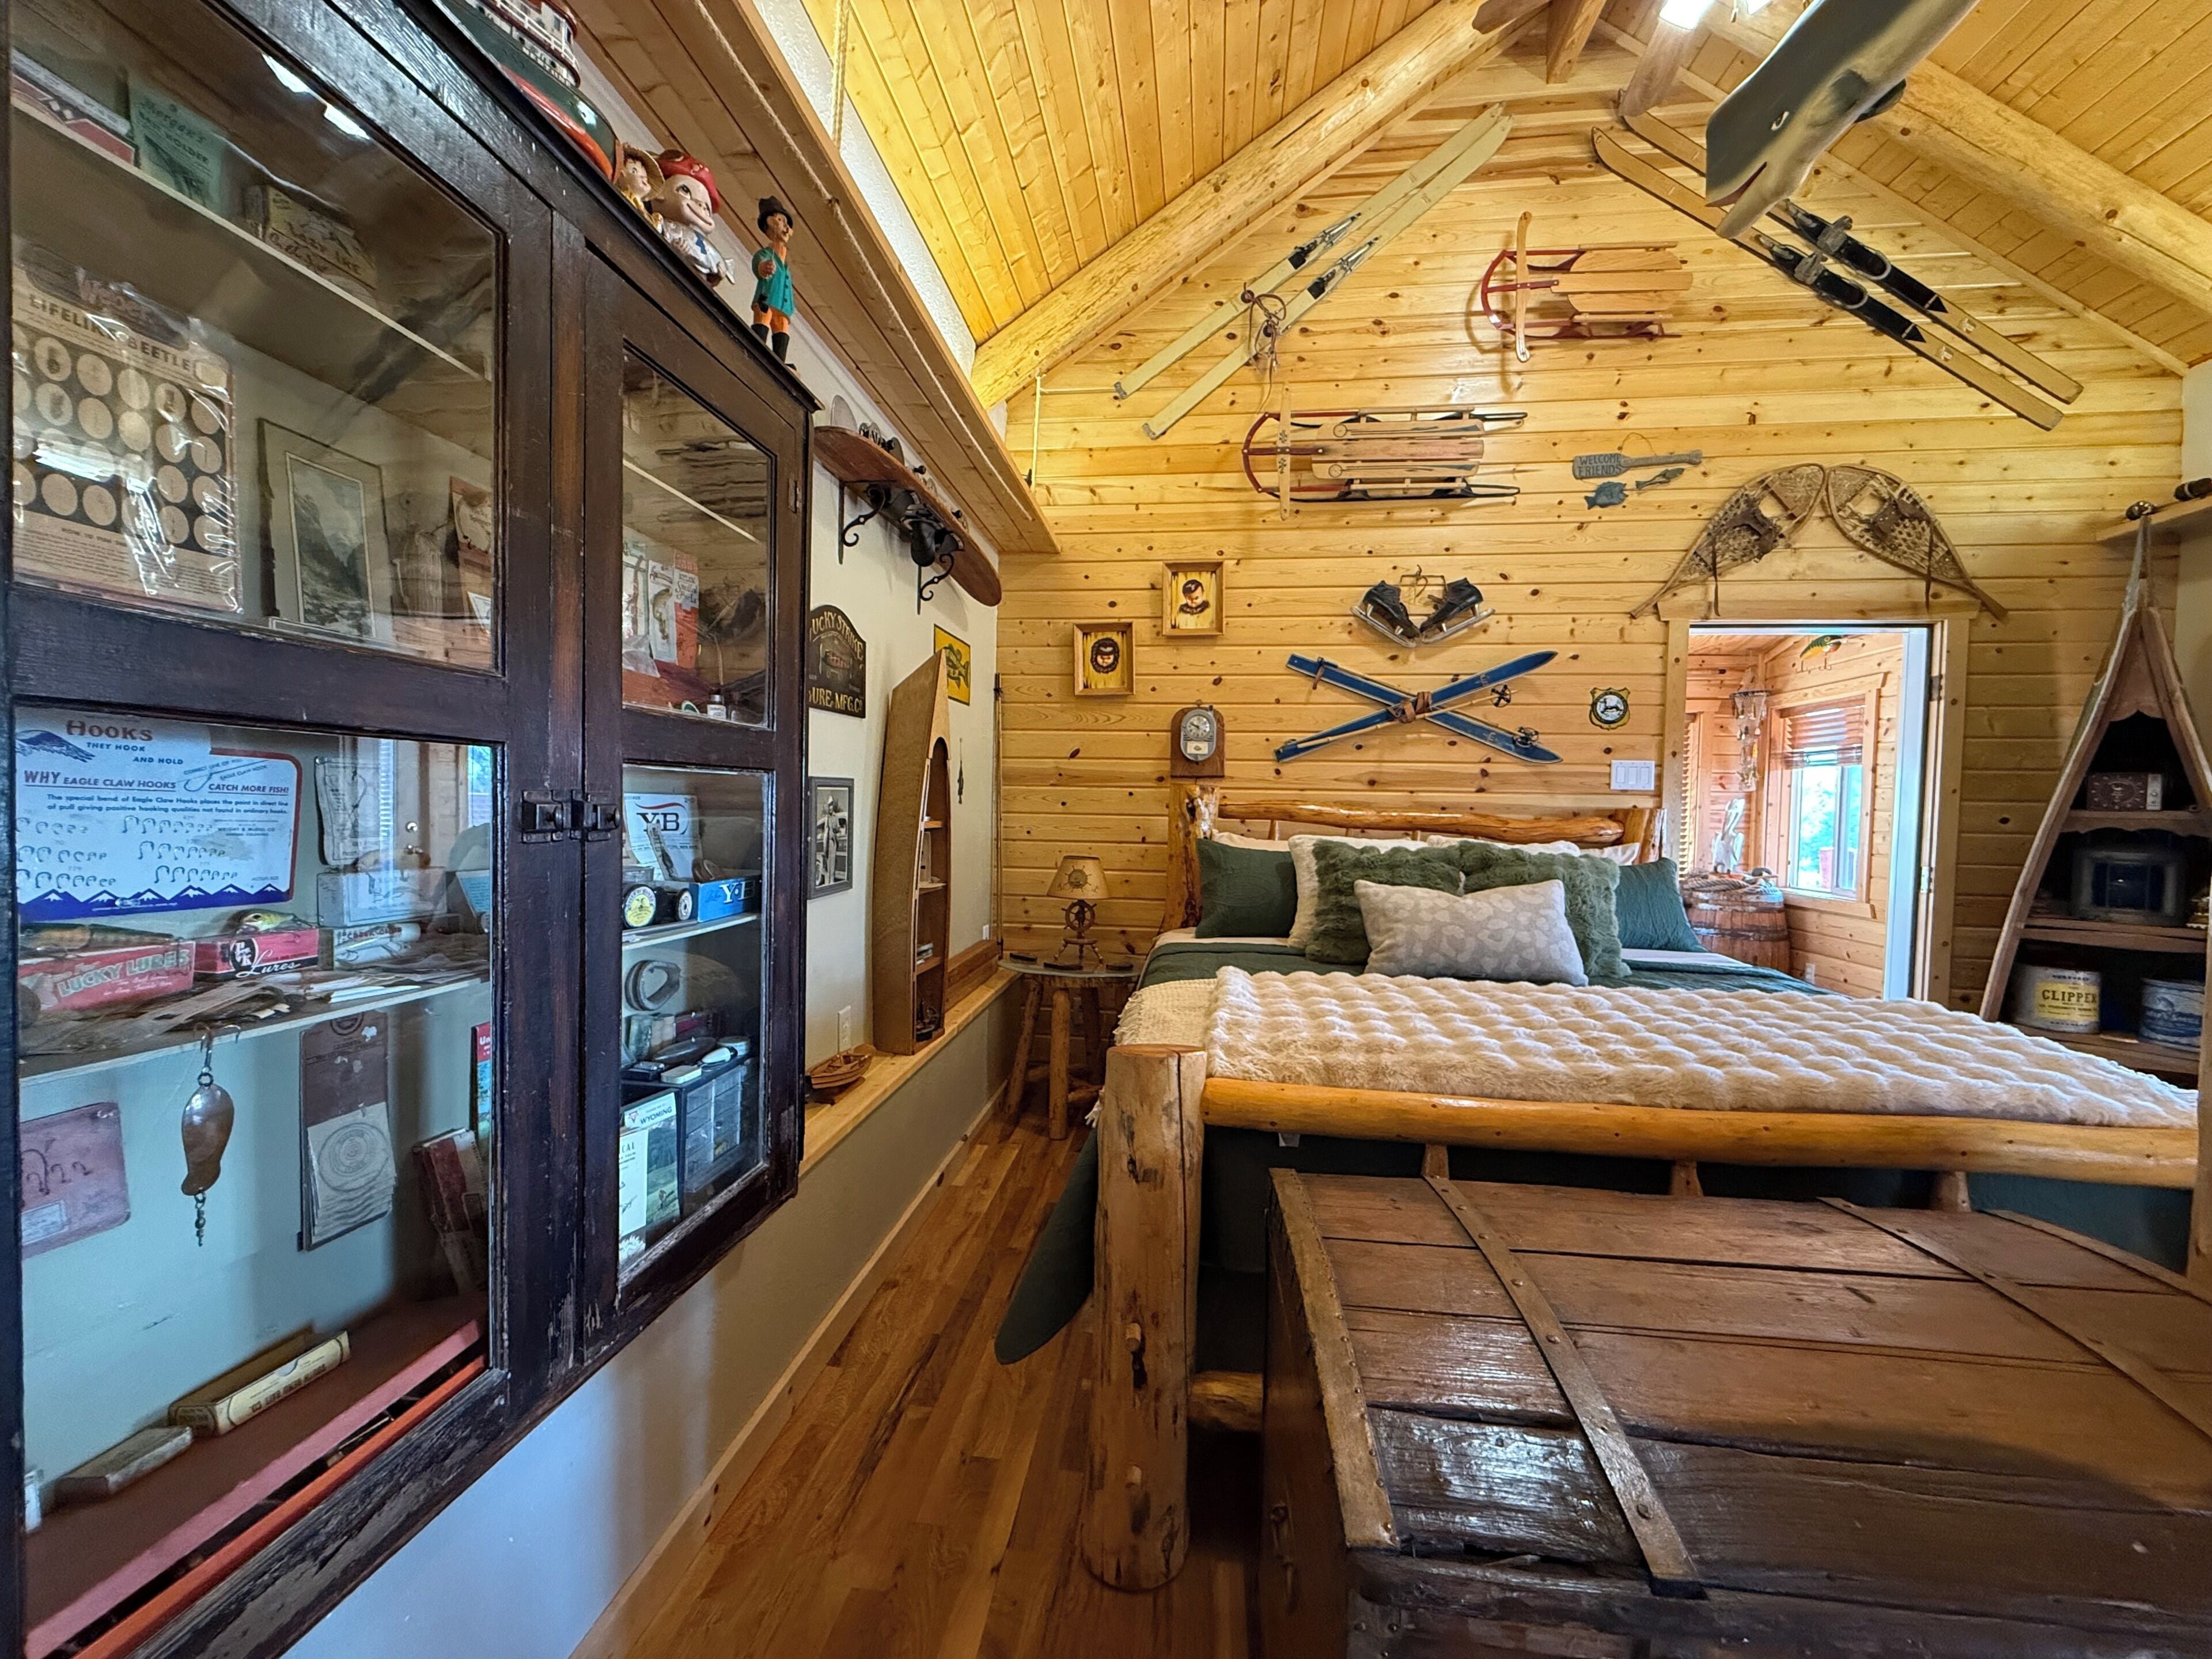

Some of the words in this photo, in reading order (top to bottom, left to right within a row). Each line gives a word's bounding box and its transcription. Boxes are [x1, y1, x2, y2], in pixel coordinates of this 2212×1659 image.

[1579, 453, 1621, 465] WELCOME
[1578, 464, 1622, 476] FRIENDS
[836, 615, 863, 661] STRIKE
[86, 742, 111, 750] THEY
[115, 744, 145, 752] HOOK
[24, 770, 60, 784] WHY
[63, 777, 99, 786] EAGLE
[103, 778, 135, 787] CLAW
[138, 779, 176, 789] HOOKS
[237, 768, 252, 777] CLAW
[235, 949, 301, 978] Lures
[56, 963, 123, 998] LUCKY
[126, 949, 190, 976] LURES
[640, 1106, 673, 1124] WYOMING
